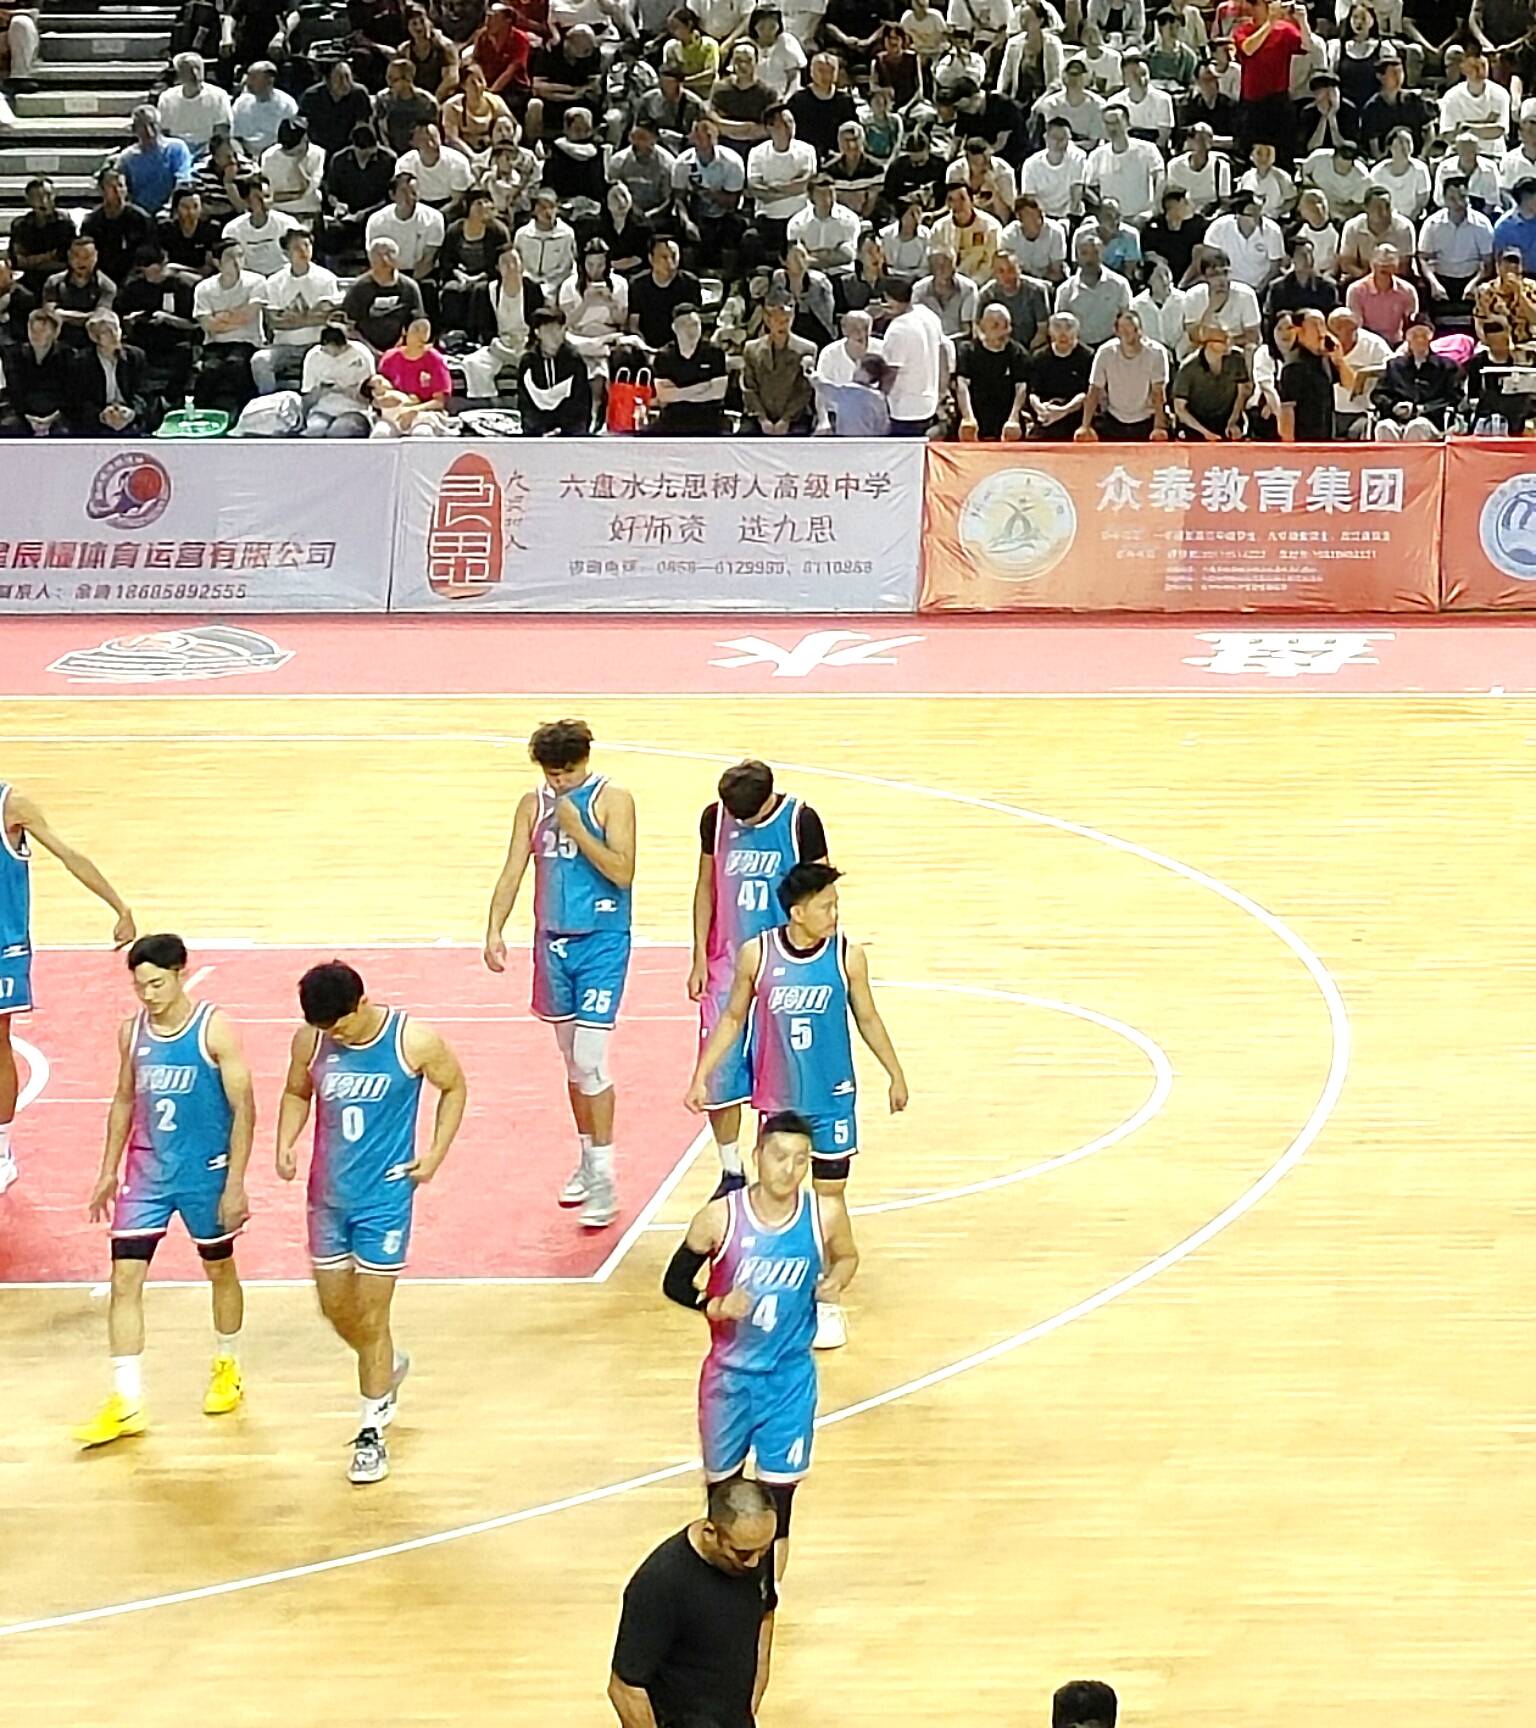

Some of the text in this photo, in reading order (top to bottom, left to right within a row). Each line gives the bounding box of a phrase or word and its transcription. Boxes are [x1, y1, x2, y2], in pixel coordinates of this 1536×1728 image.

[559, 472, 892, 501] 六盘水九思树人高级中学
[1096, 465, 1404, 514] 众泰教育集团
[609, 514, 837, 546] 好师资 选九思
[0, 541, 336, 571] 辰耀体育运营有限公司
[737, 880, 770, 912] 47
[790, 1017, 813, 1051] 5
[154, 1098, 178, 1132] 2
[341, 1105, 366, 1142] 0
[833, 1119, 849, 1145] 5
[752, 1293, 779, 1333] 4
